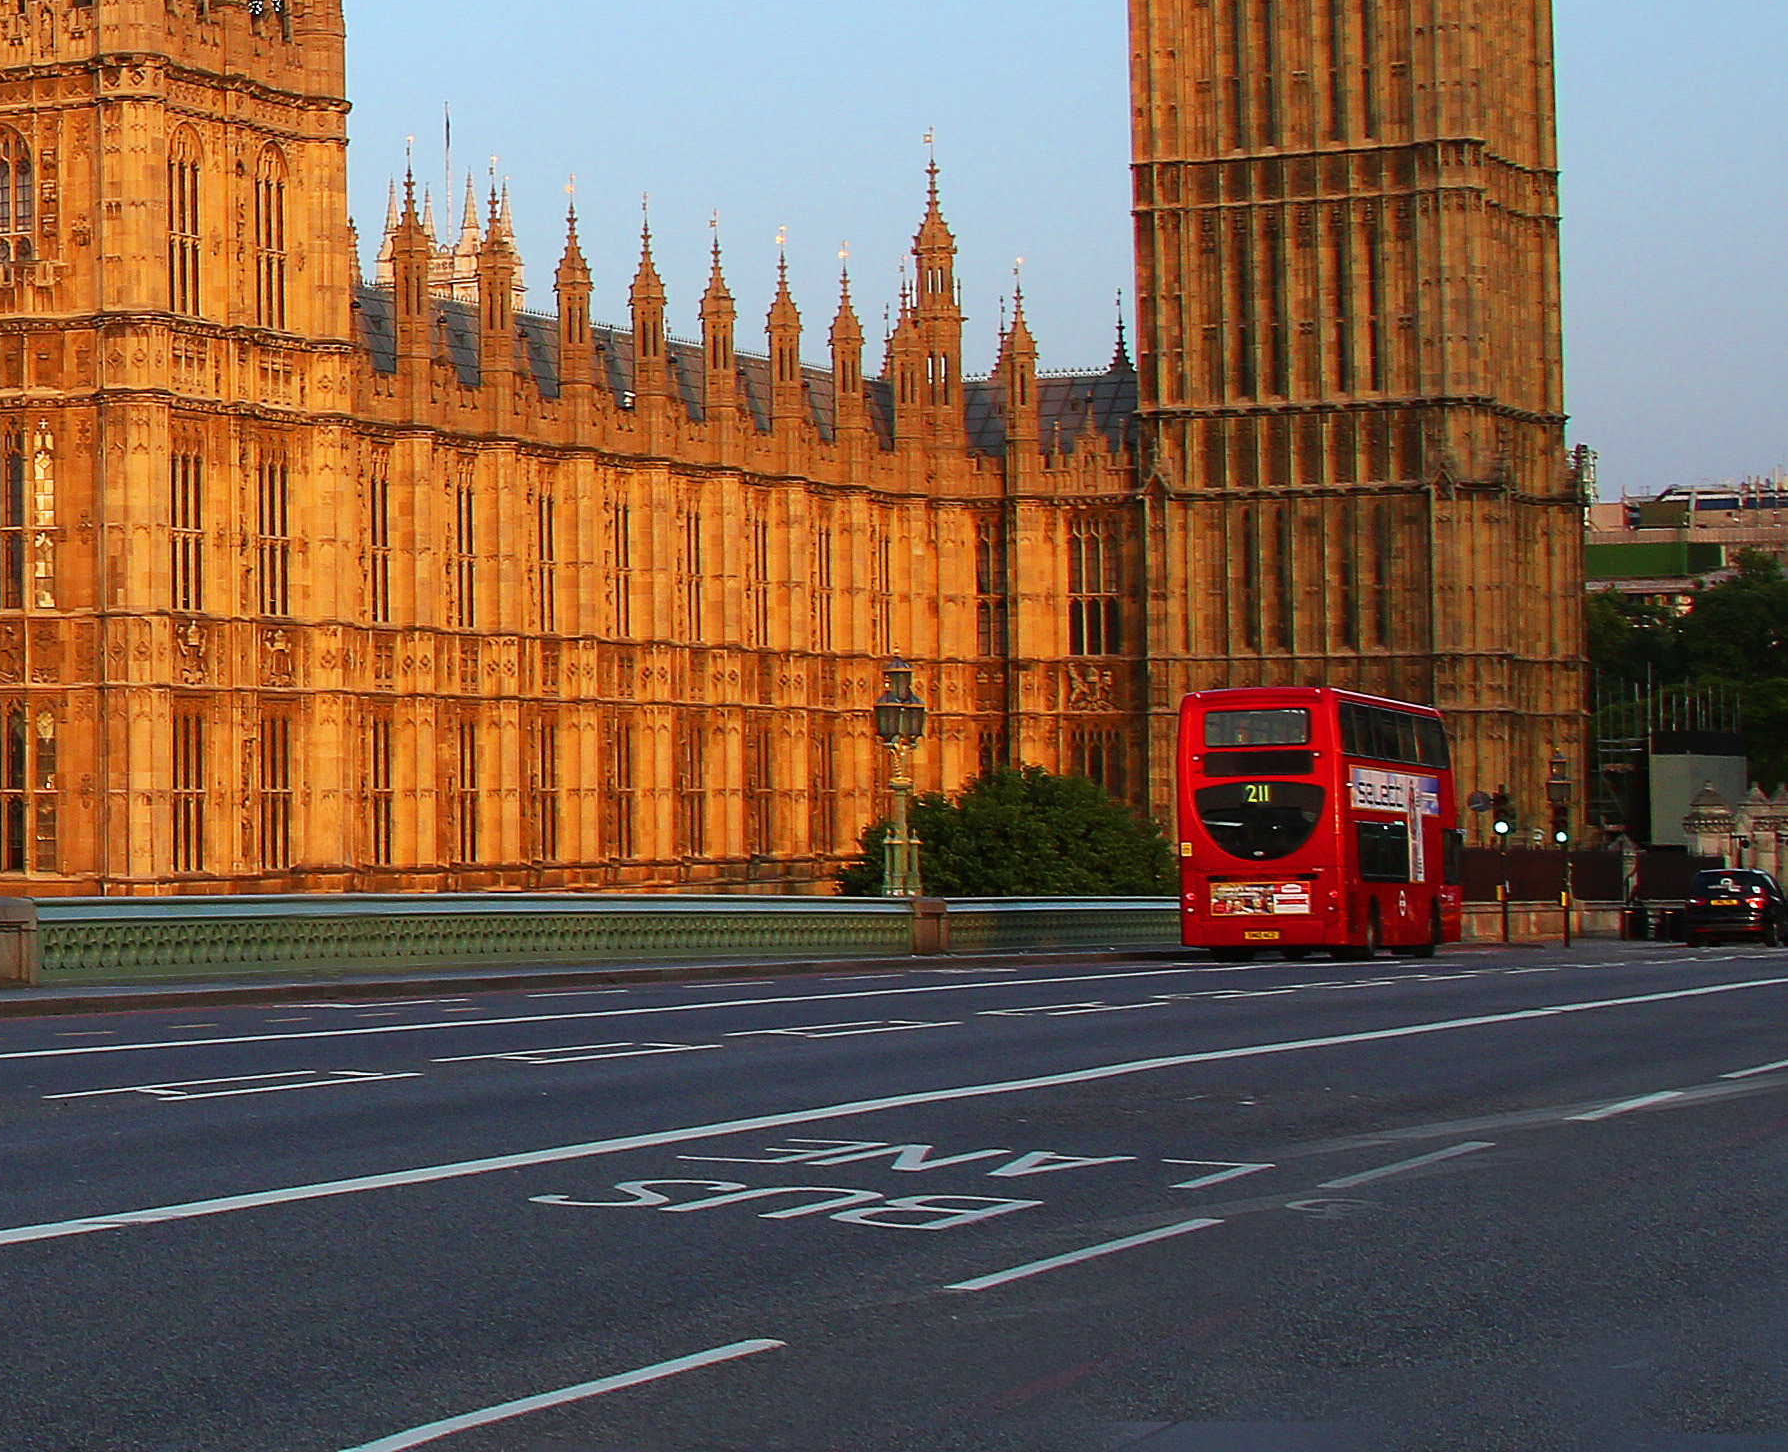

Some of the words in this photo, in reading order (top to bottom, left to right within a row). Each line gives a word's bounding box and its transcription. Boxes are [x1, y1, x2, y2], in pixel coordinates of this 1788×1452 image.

[1245, 784, 1268, 802] 211
[676, 1138, 1275, 1188] LANE
[528, 1179, 1044, 1231] BUS
